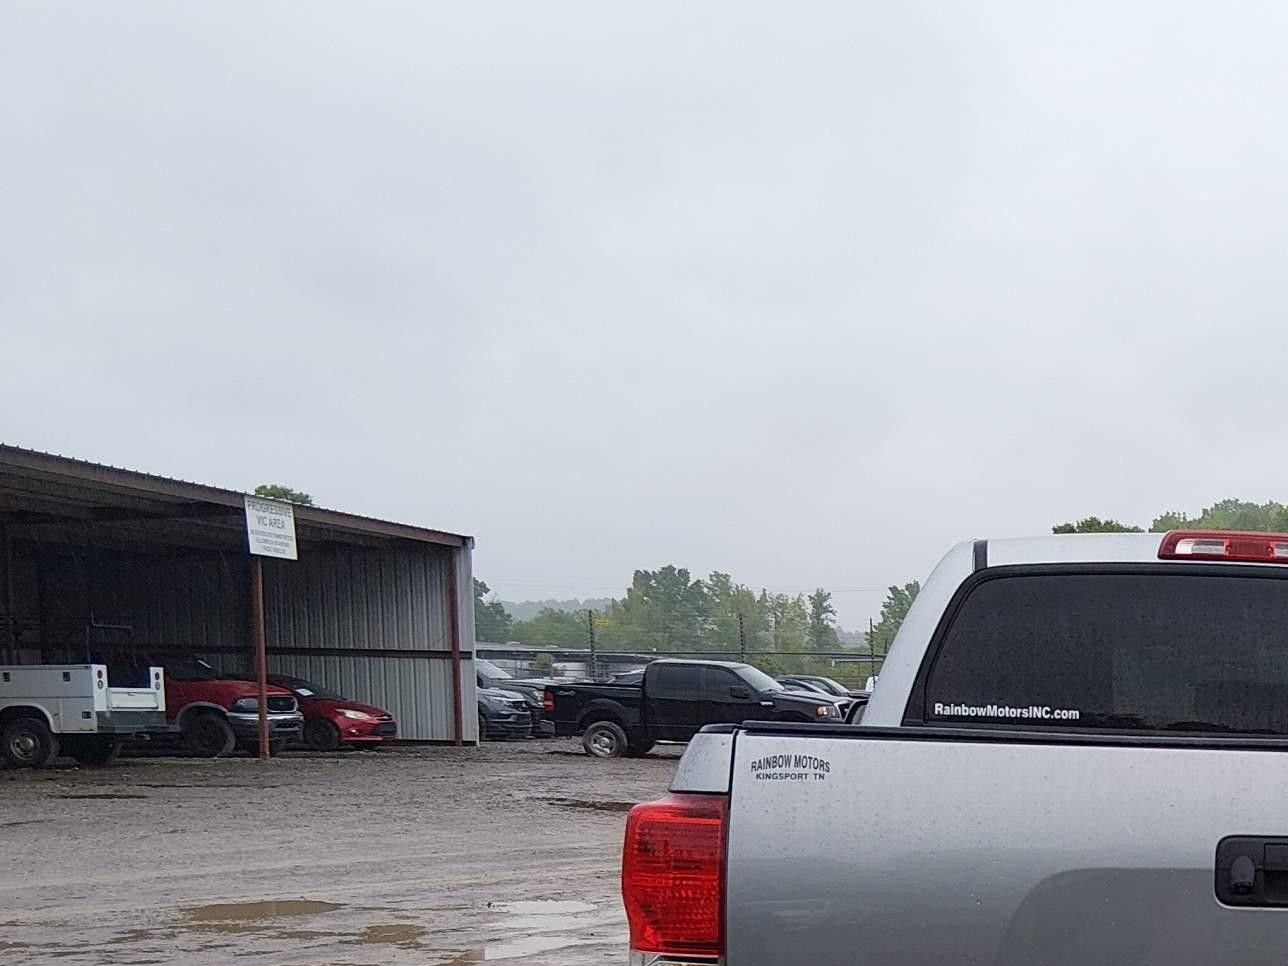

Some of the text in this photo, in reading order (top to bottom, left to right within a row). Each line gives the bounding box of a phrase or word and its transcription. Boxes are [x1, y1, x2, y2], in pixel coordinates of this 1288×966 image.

[934, 703, 1080, 720] RainbowMotorsINC.com
[751, 754, 831, 773] RAINBOW MOTORS
[756, 772, 809, 780] KINGSPORT
